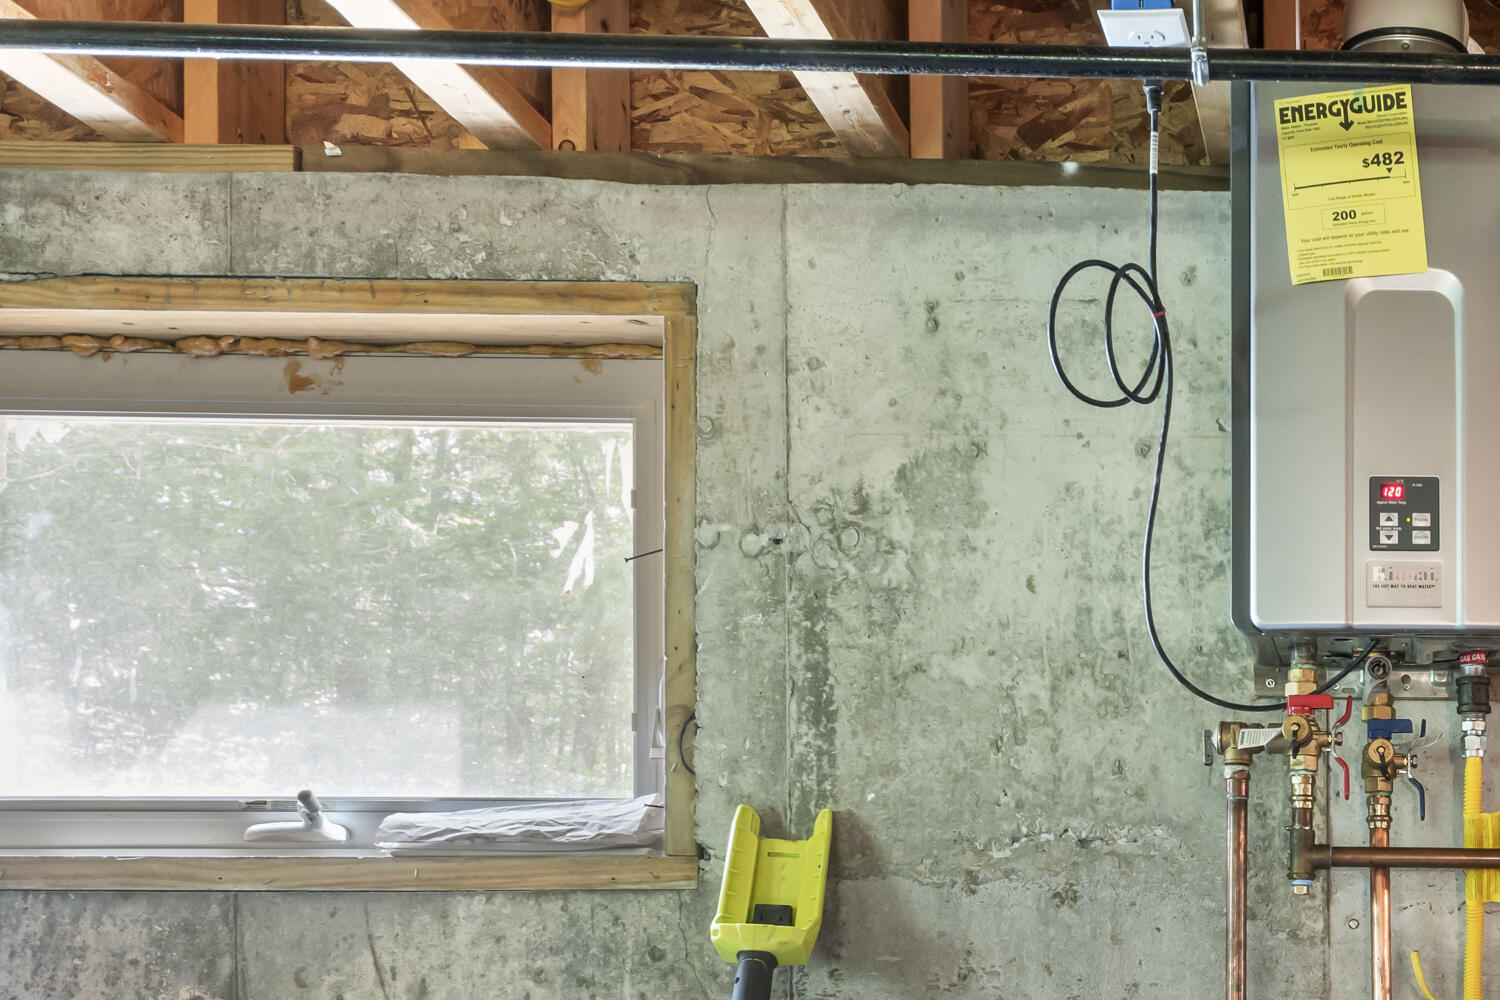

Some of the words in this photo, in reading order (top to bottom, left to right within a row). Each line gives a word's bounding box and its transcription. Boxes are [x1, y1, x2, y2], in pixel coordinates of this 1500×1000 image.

[1279, 92, 1407, 124] ENERGYGUIDE
[1334, 143, 1347, 151] Yearly
[1349, 141, 1371, 149] Operating
[1362, 151, 1404, 168] $482
[1332, 210, 1356, 221] 200
[1384, 487, 1402, 497] 120
[1460, 654, 1470, 662] GAS
